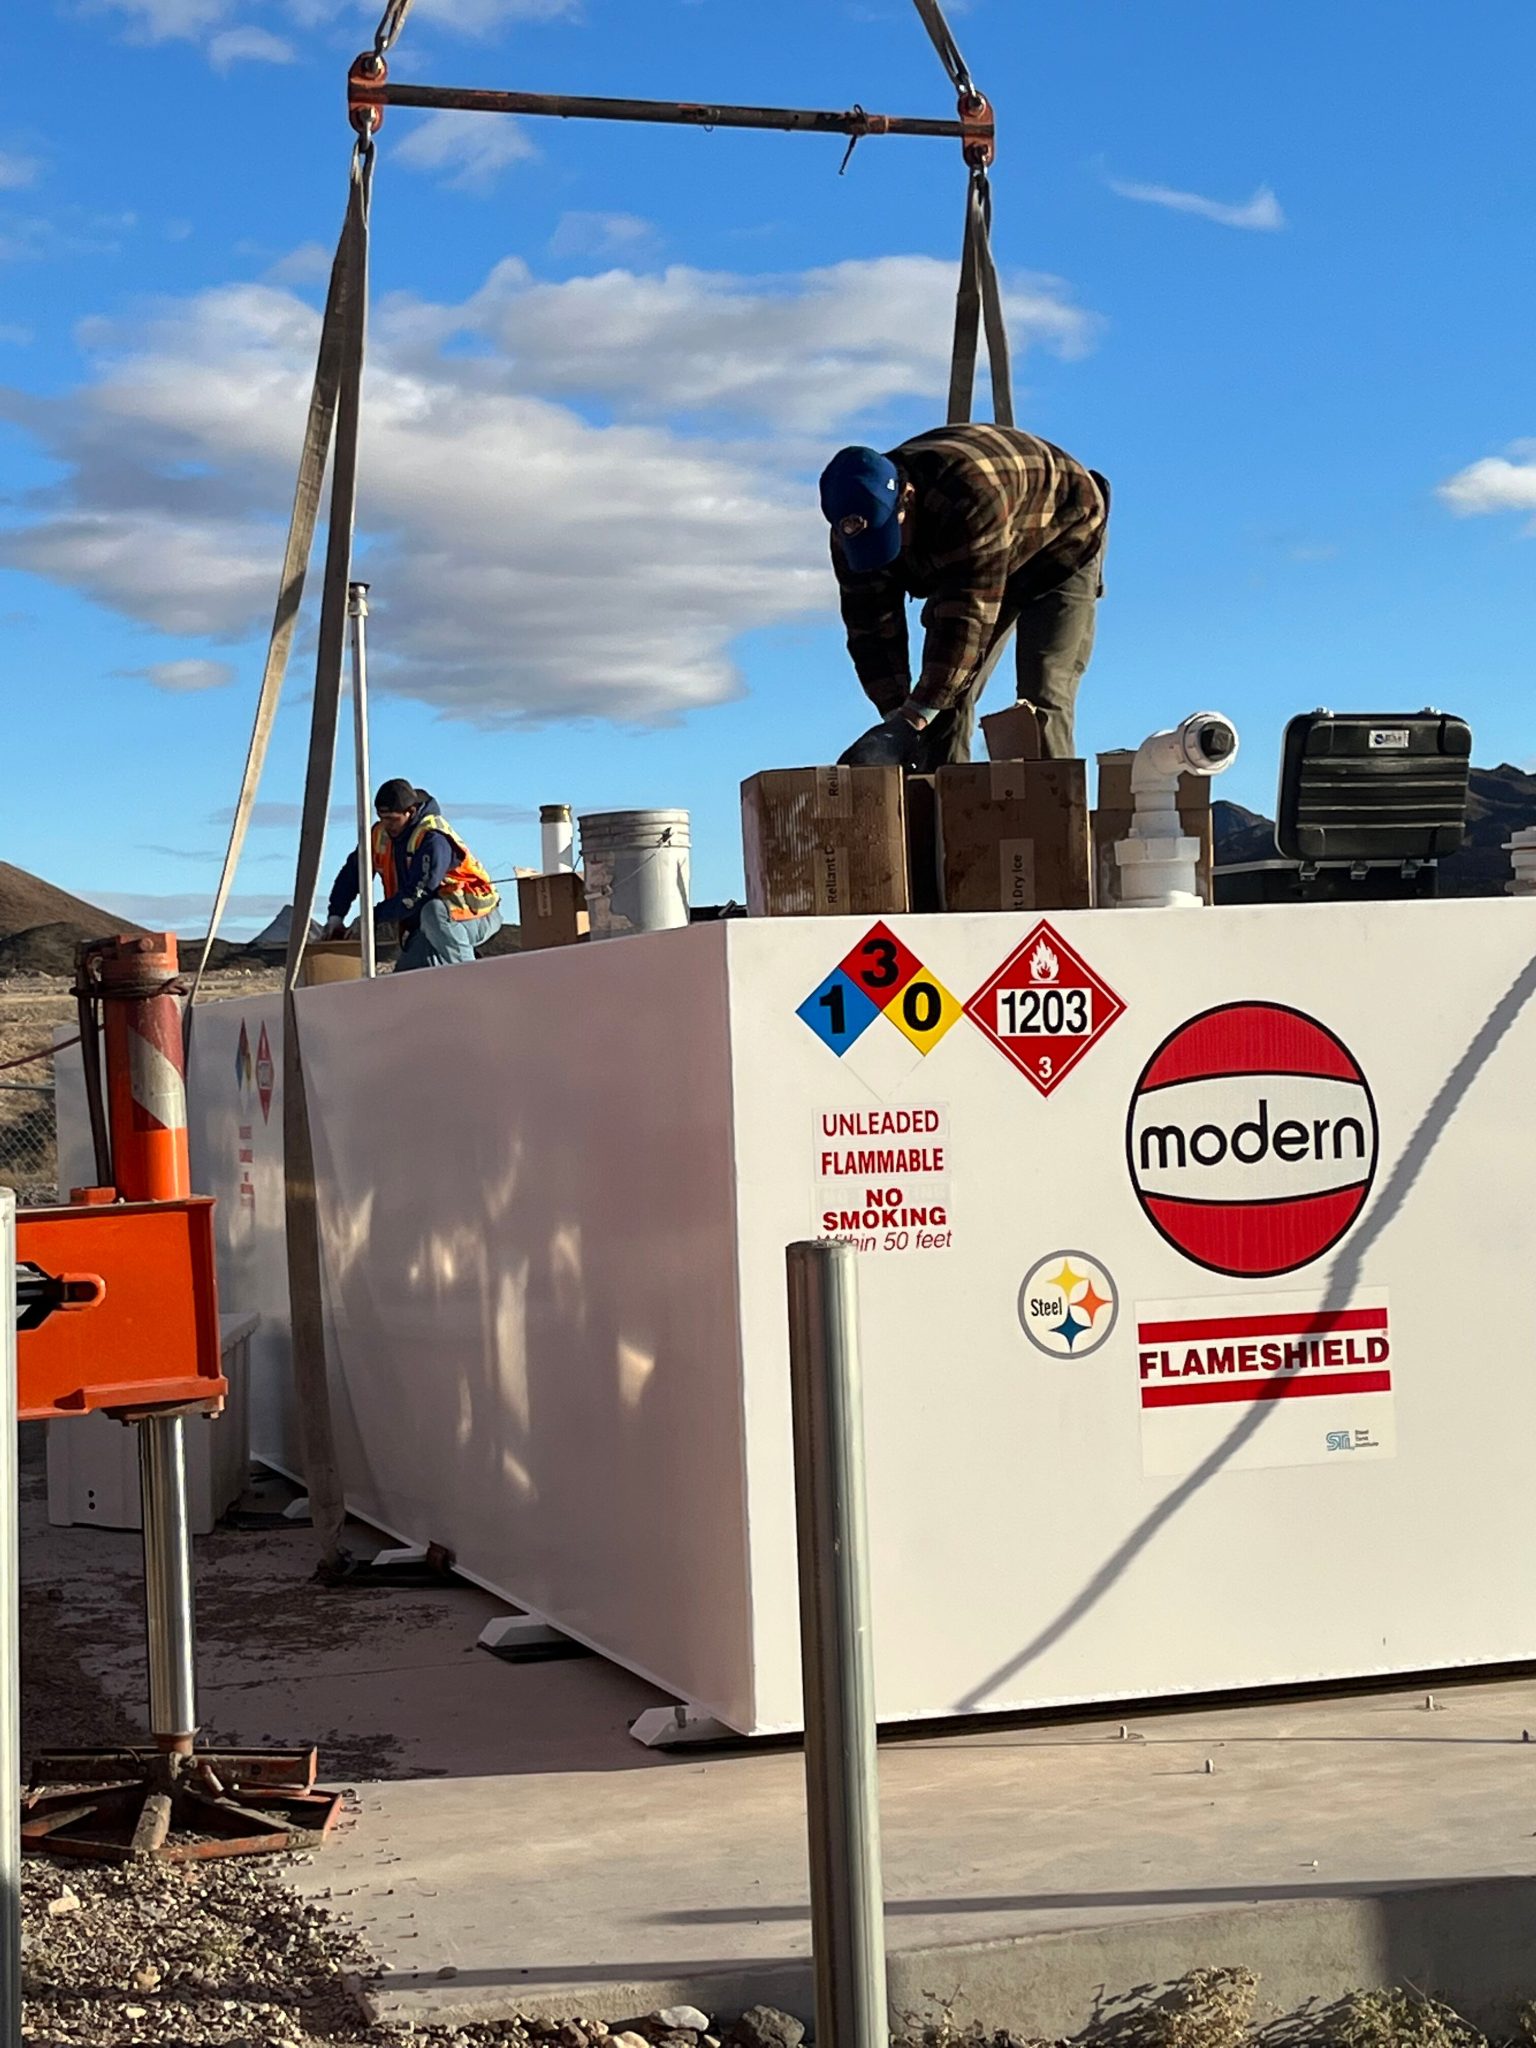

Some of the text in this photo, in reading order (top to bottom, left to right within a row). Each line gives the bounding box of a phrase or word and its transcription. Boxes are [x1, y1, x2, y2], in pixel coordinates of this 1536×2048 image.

[1011, 855, 1023, 873] Ice
[825, 858, 838, 904] Reliant
[1012, 876, 1025, 898] Dry
[861, 938, 899, 988] 3
[819, 985, 845, 1034] 1
[903, 982, 941, 1031] 0
[1001, 990, 1088, 1034] 1203
[1038, 1056, 1052, 1078] 3
[822, 1109, 940, 1137] UNLEADED
[1140, 1099, 1365, 1169] modern
[821, 1148, 944, 1175] FLAMMABLE
[865, 1187, 903, 1208] NO
[822, 1206, 947, 1231] SMOKING
[817, 1229, 952, 1252] hin 50 feet
[1030, 1296, 1063, 1317] Steel
[1138, 1336, 1390, 1379] FLAMESHIELD
